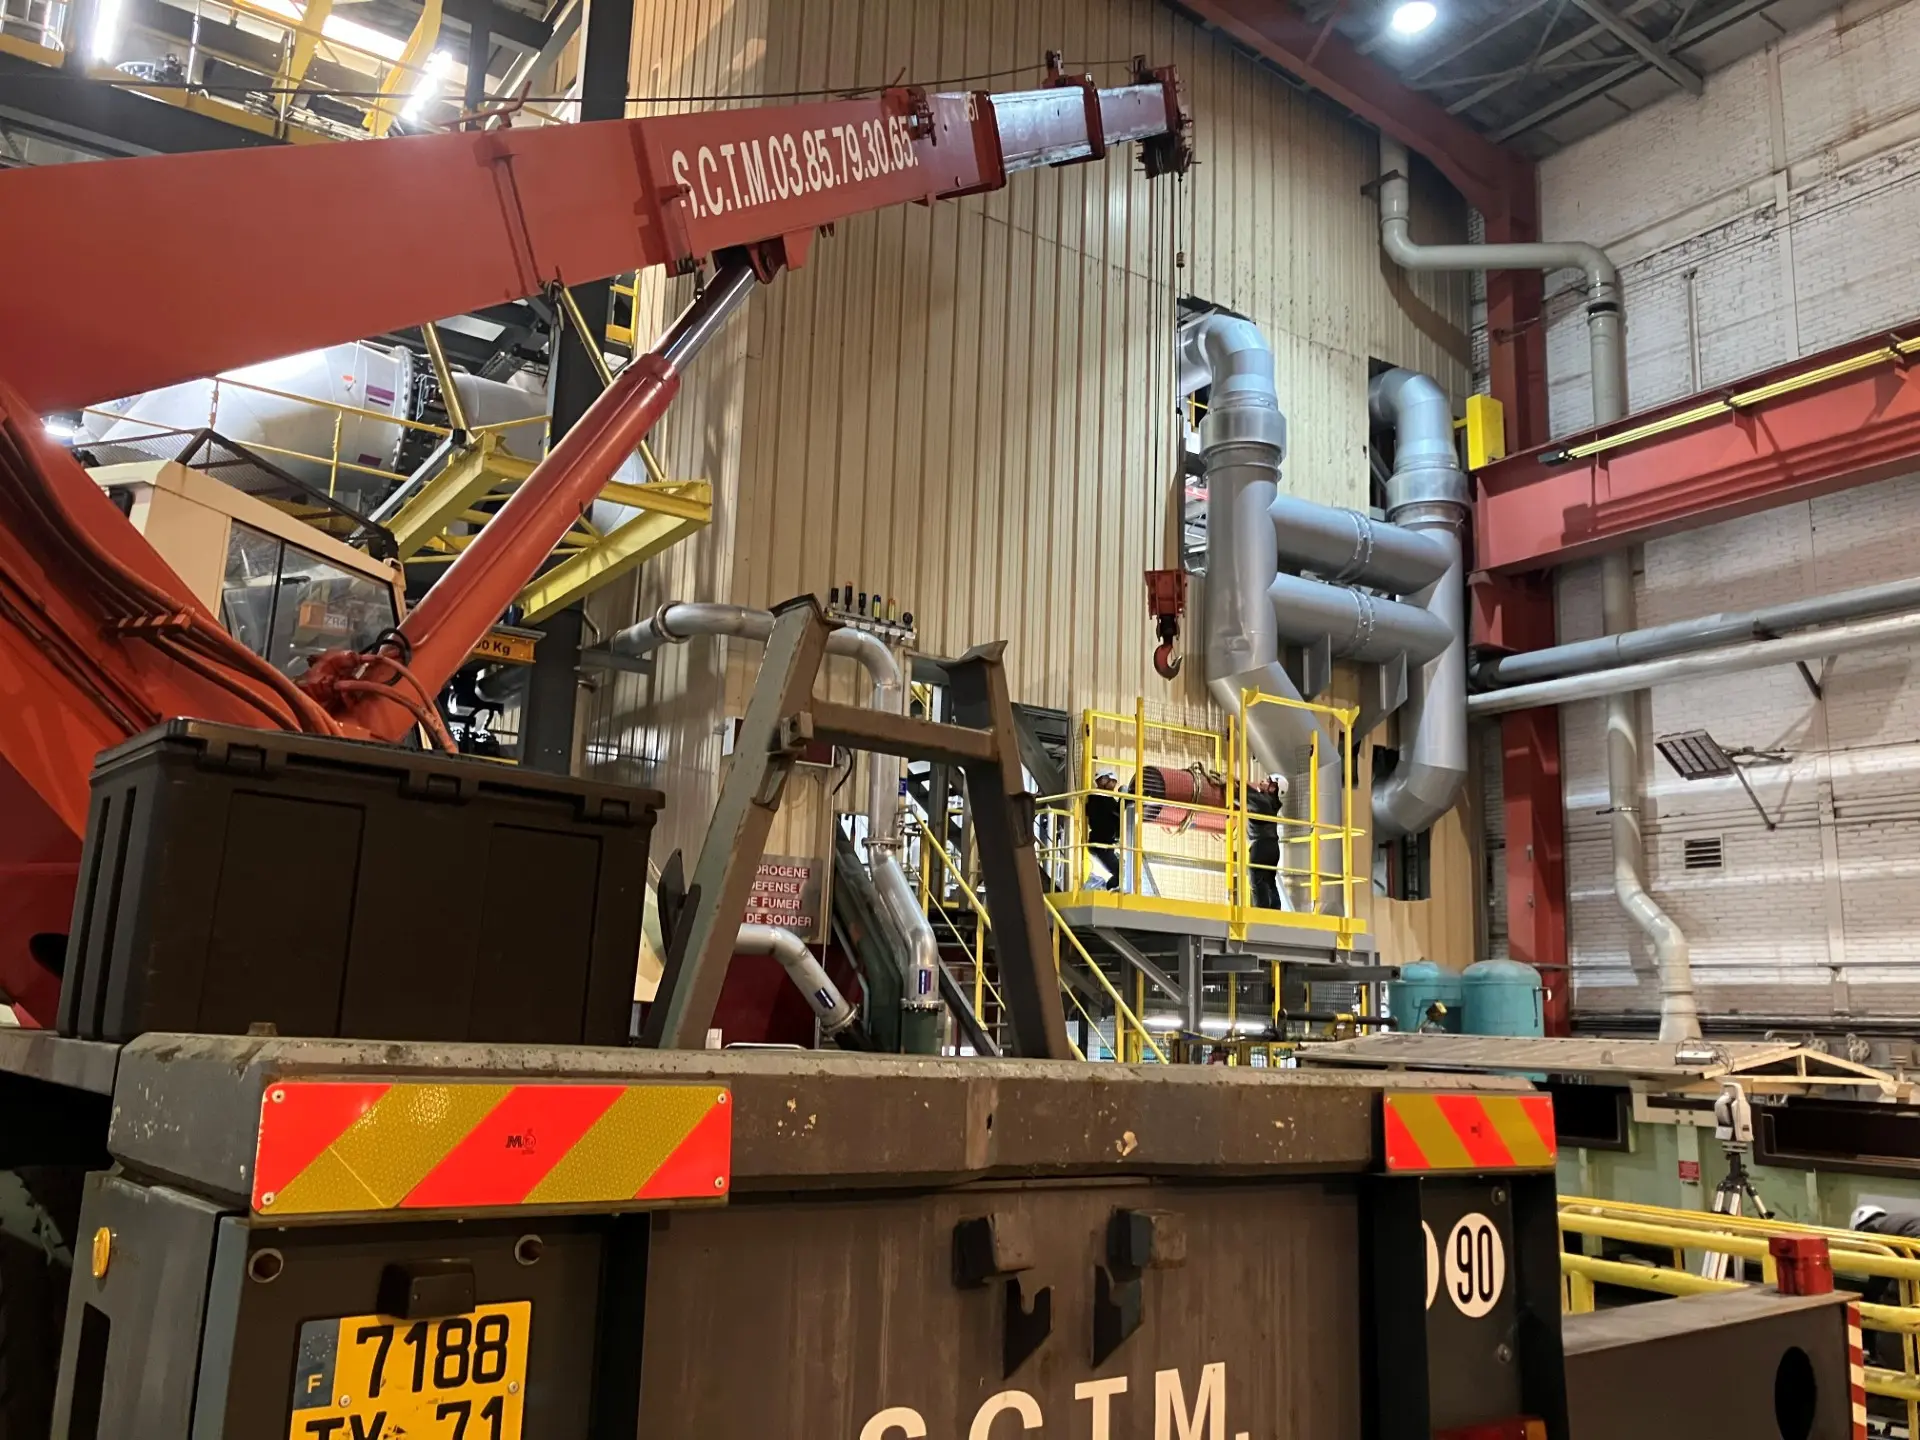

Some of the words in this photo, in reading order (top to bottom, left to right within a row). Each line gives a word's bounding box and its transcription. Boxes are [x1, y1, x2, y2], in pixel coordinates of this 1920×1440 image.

[493, 641, 511, 656] Kg
[762, 898, 801, 909] FUMER
[746, 913, 762, 924] DE
[766, 914, 812, 926] SOUDER
[1457, 1225, 1494, 1304] 90
[356, 1314, 510, 1398] 7188
[307, 1374, 323, 1394] F
